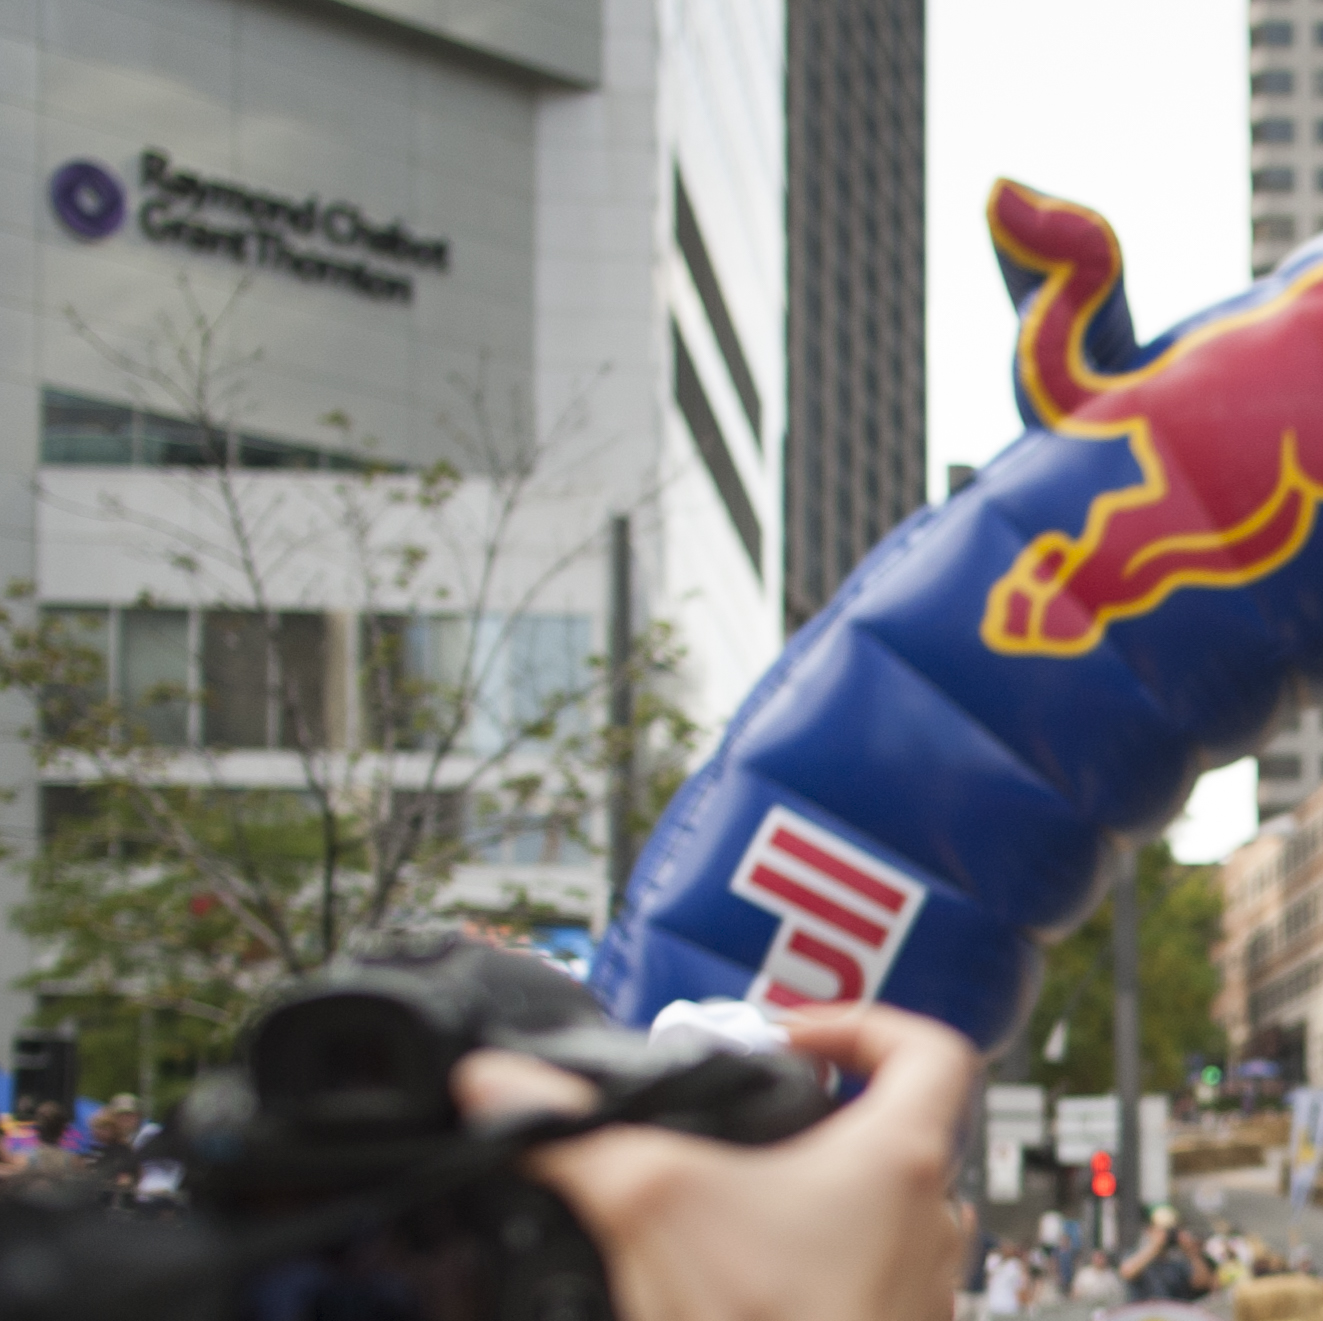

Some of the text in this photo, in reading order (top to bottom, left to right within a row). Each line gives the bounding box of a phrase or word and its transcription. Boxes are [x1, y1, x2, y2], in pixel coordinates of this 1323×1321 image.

[138, 200, 246, 264] Grant
[139, 147, 317, 237] Raymond
[748, 824, 908, 1010] ull
